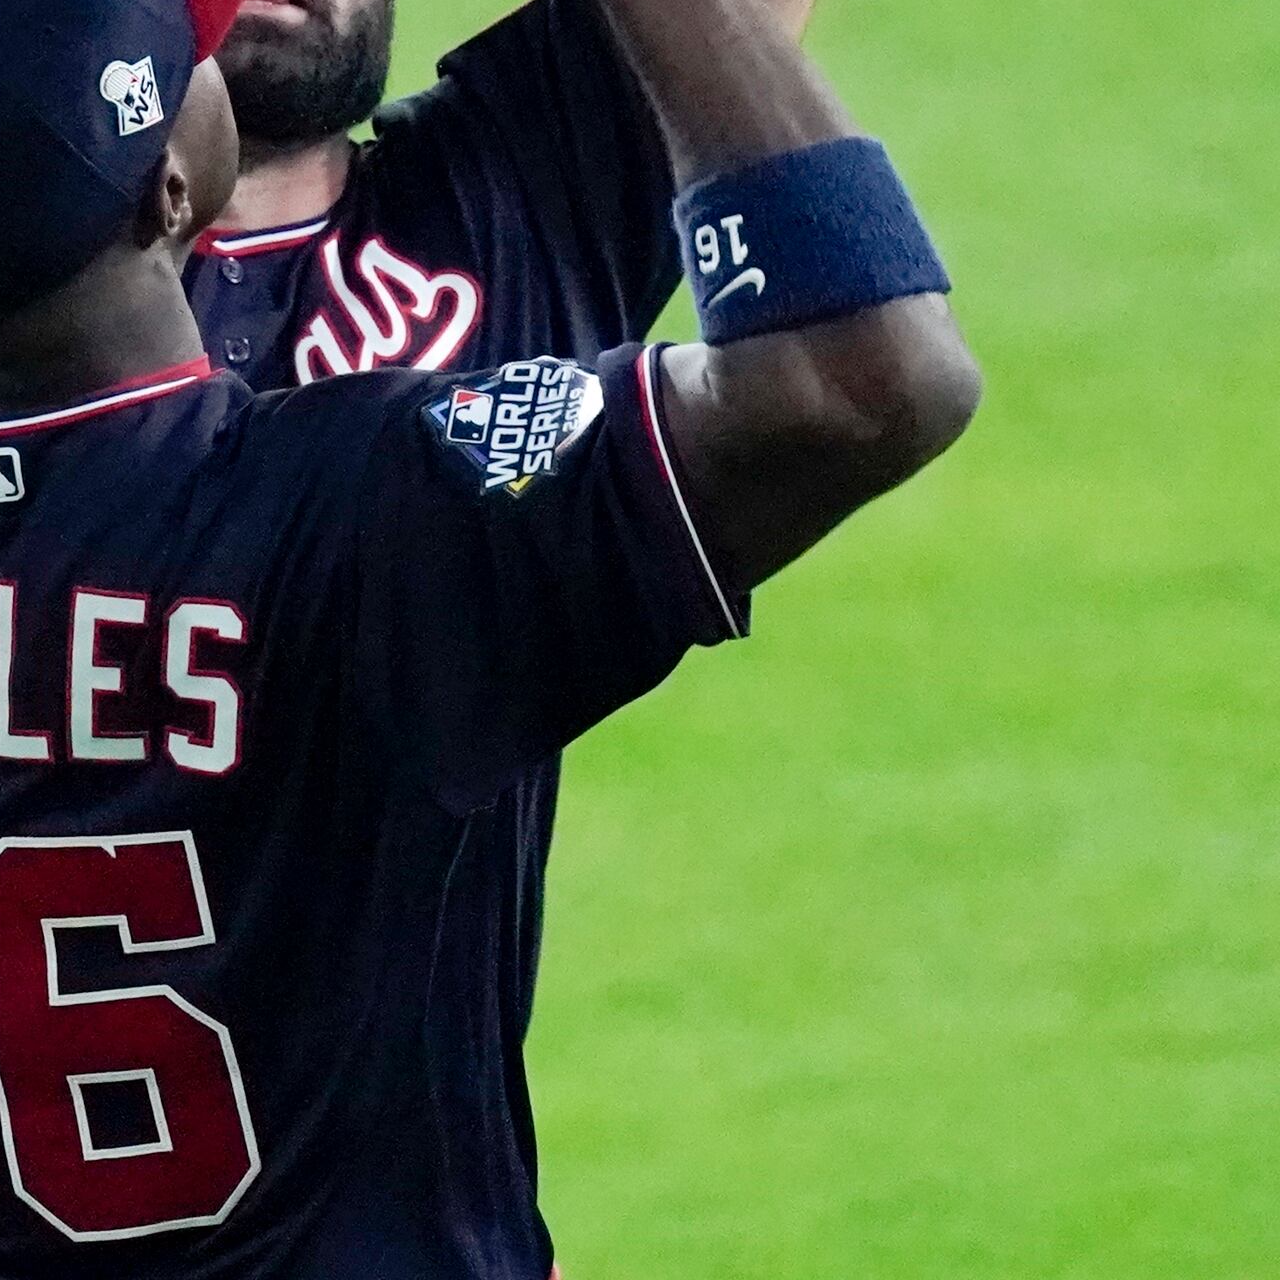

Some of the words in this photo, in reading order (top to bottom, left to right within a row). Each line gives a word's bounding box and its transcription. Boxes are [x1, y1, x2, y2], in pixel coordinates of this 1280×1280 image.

[695, 213, 749, 275] 16
[485, 362, 541, 489] WORLD
[522, 365, 572, 474] SERIES
[562, 387, 584, 433] 2019
